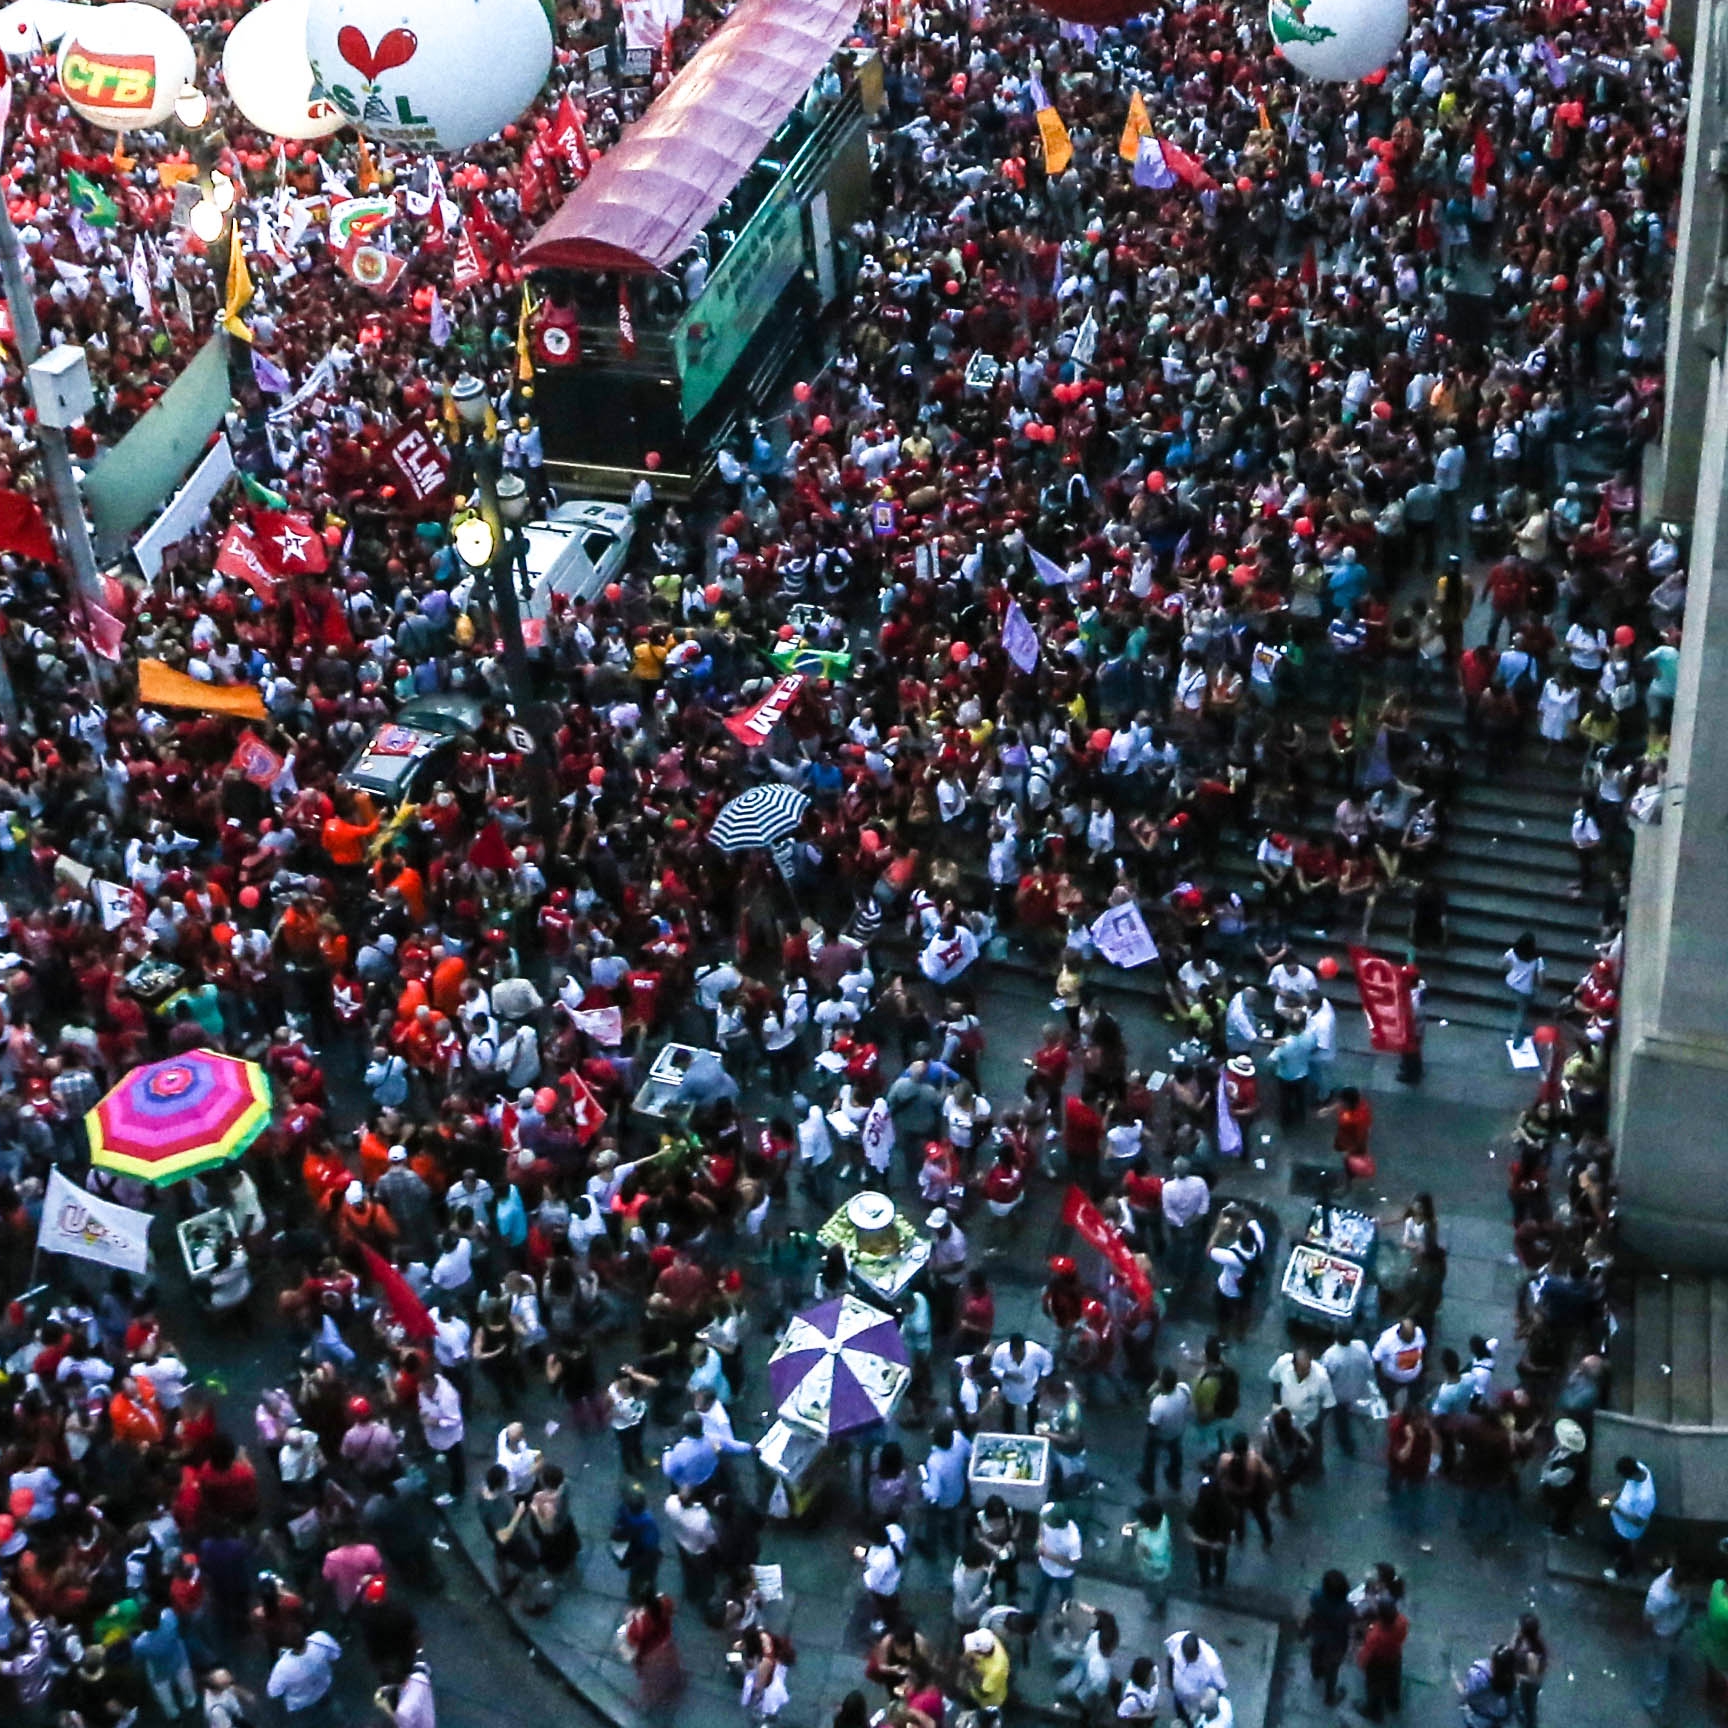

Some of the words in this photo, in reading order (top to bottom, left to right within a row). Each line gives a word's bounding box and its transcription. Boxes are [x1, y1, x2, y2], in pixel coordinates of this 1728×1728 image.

[63, 54, 151, 102] CTB
[397, 429, 446, 495] FLM
[285, 538, 301, 550] PT
